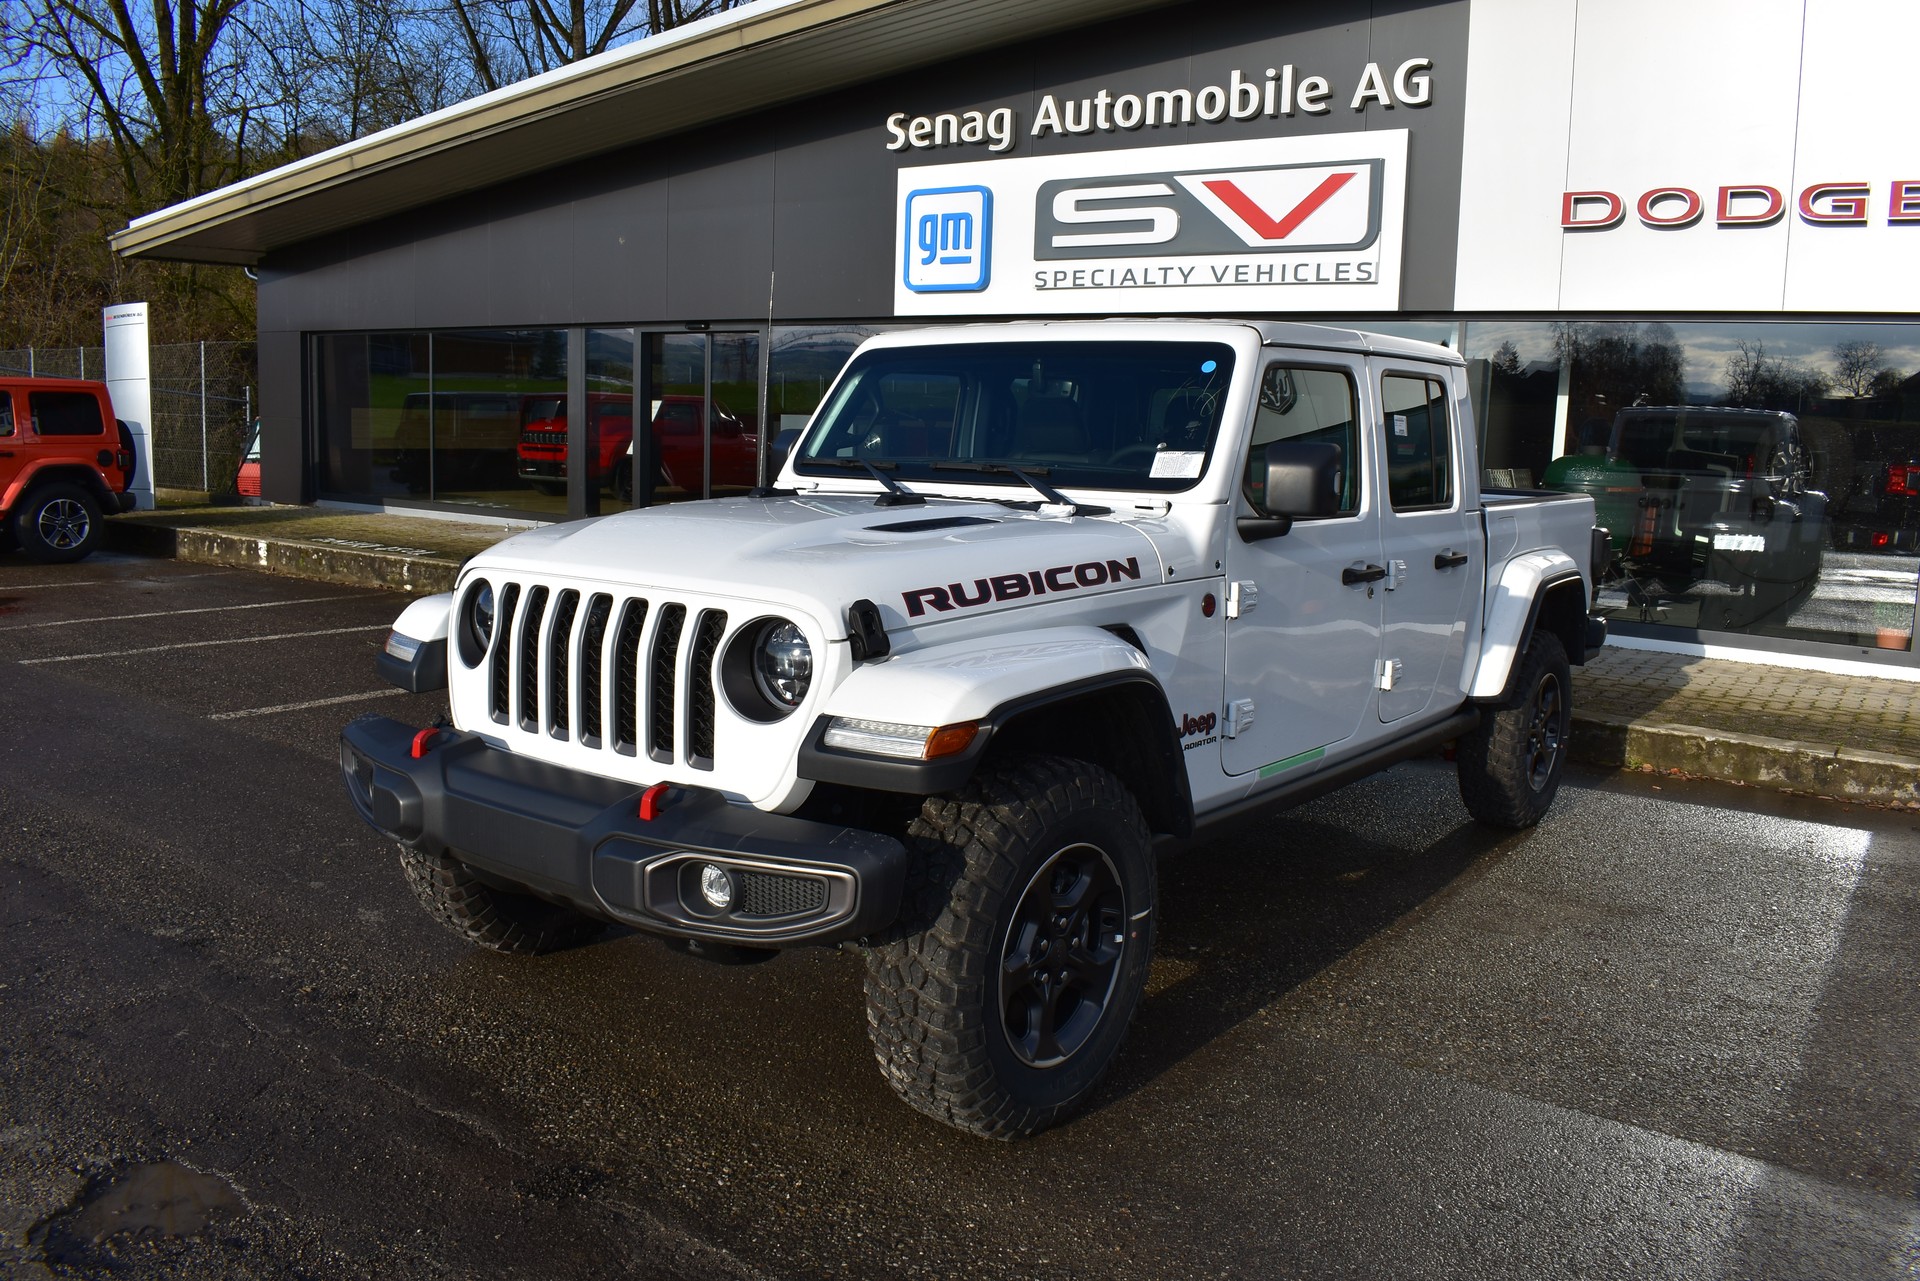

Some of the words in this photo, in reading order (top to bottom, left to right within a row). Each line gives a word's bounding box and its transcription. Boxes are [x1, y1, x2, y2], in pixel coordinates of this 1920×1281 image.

[886, 107, 1015, 152] Senag
[1031, 64, 1331, 136] Automobile
[1350, 57, 1433, 109] AG
[1052, 171, 1358, 248] SV
[1560, 180, 1920, 230] DODGE
[918, 211, 974, 266] gm
[1034, 264, 1197, 288] SPECIALTY
[1210, 261, 1374, 285] VEHICLES
[901, 556, 1142, 618] RUBICON
[1178, 711, 1217, 739] Jeep
[1183, 735, 1217, 751] ADIATOR
